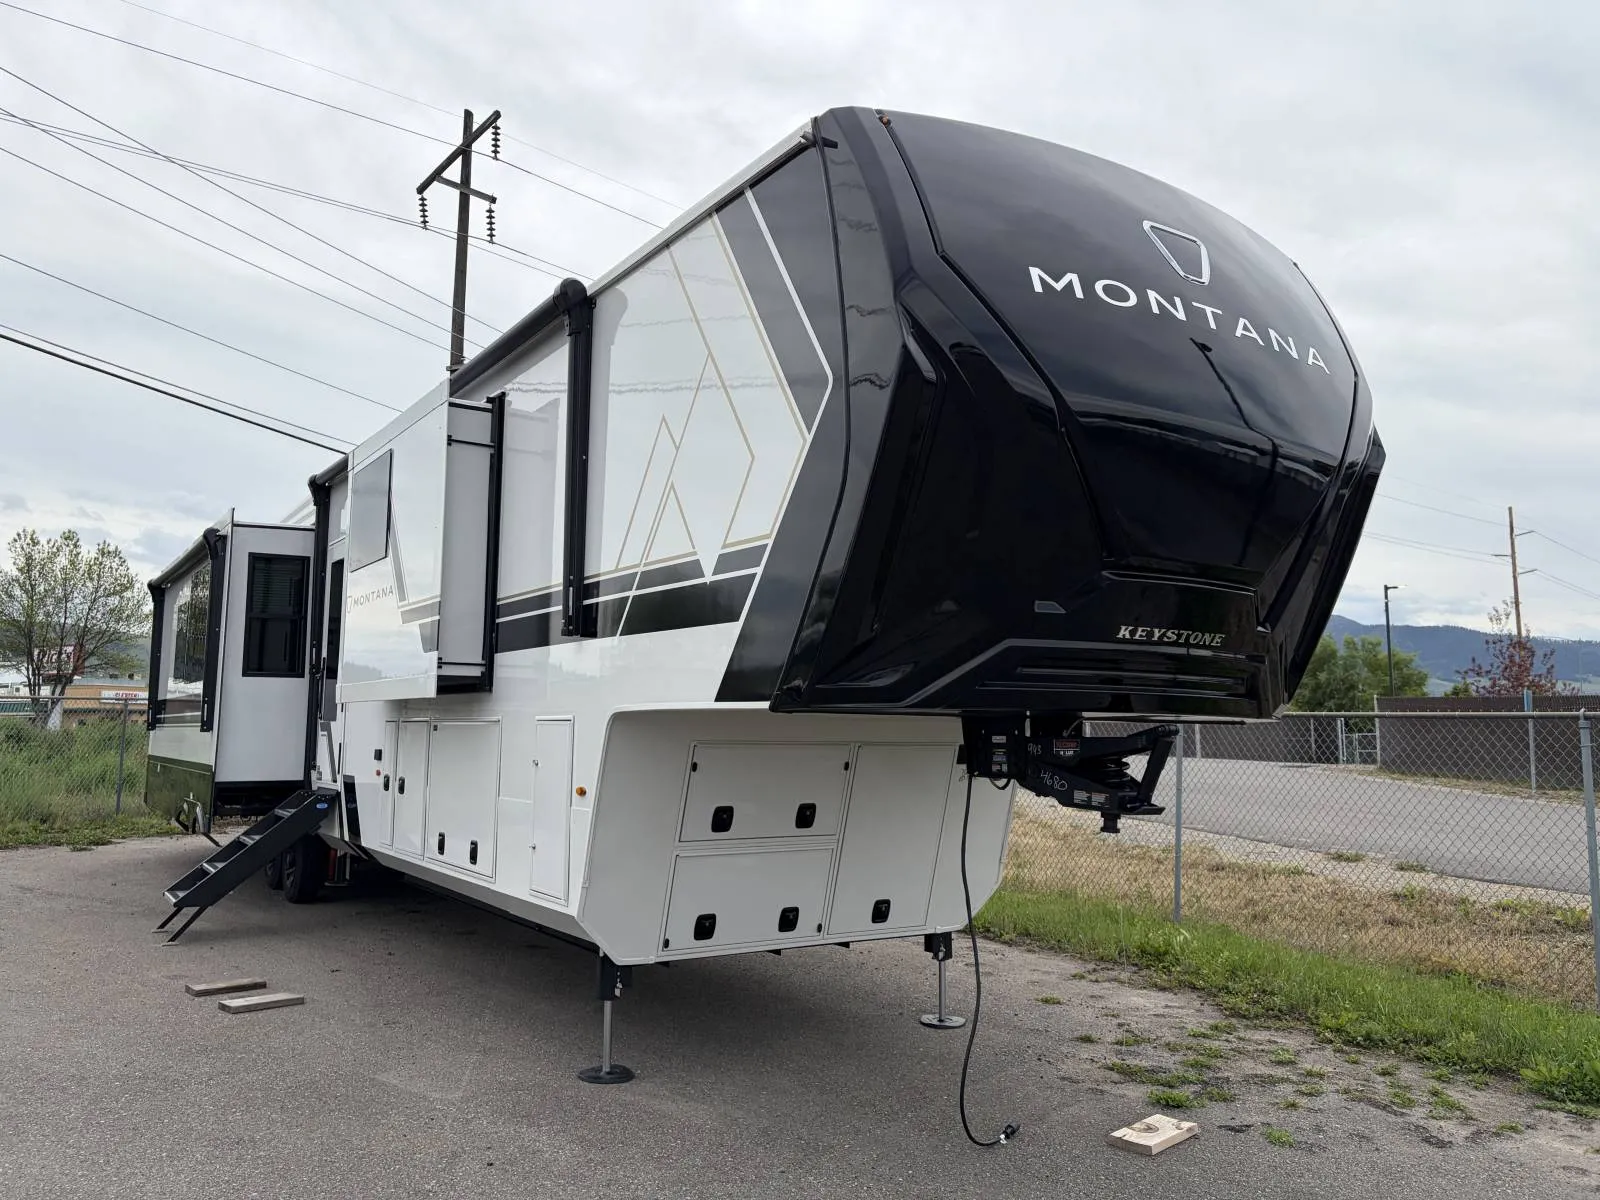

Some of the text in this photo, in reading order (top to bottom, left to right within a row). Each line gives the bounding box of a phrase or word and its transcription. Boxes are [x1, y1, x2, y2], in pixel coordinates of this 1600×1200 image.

[1028, 265, 1331, 375] MONTANA
[353, 584, 394, 608] MONTANA
[1116, 624, 1226, 646] KEYSTONE
[1040, 769, 1068, 791] 4680
